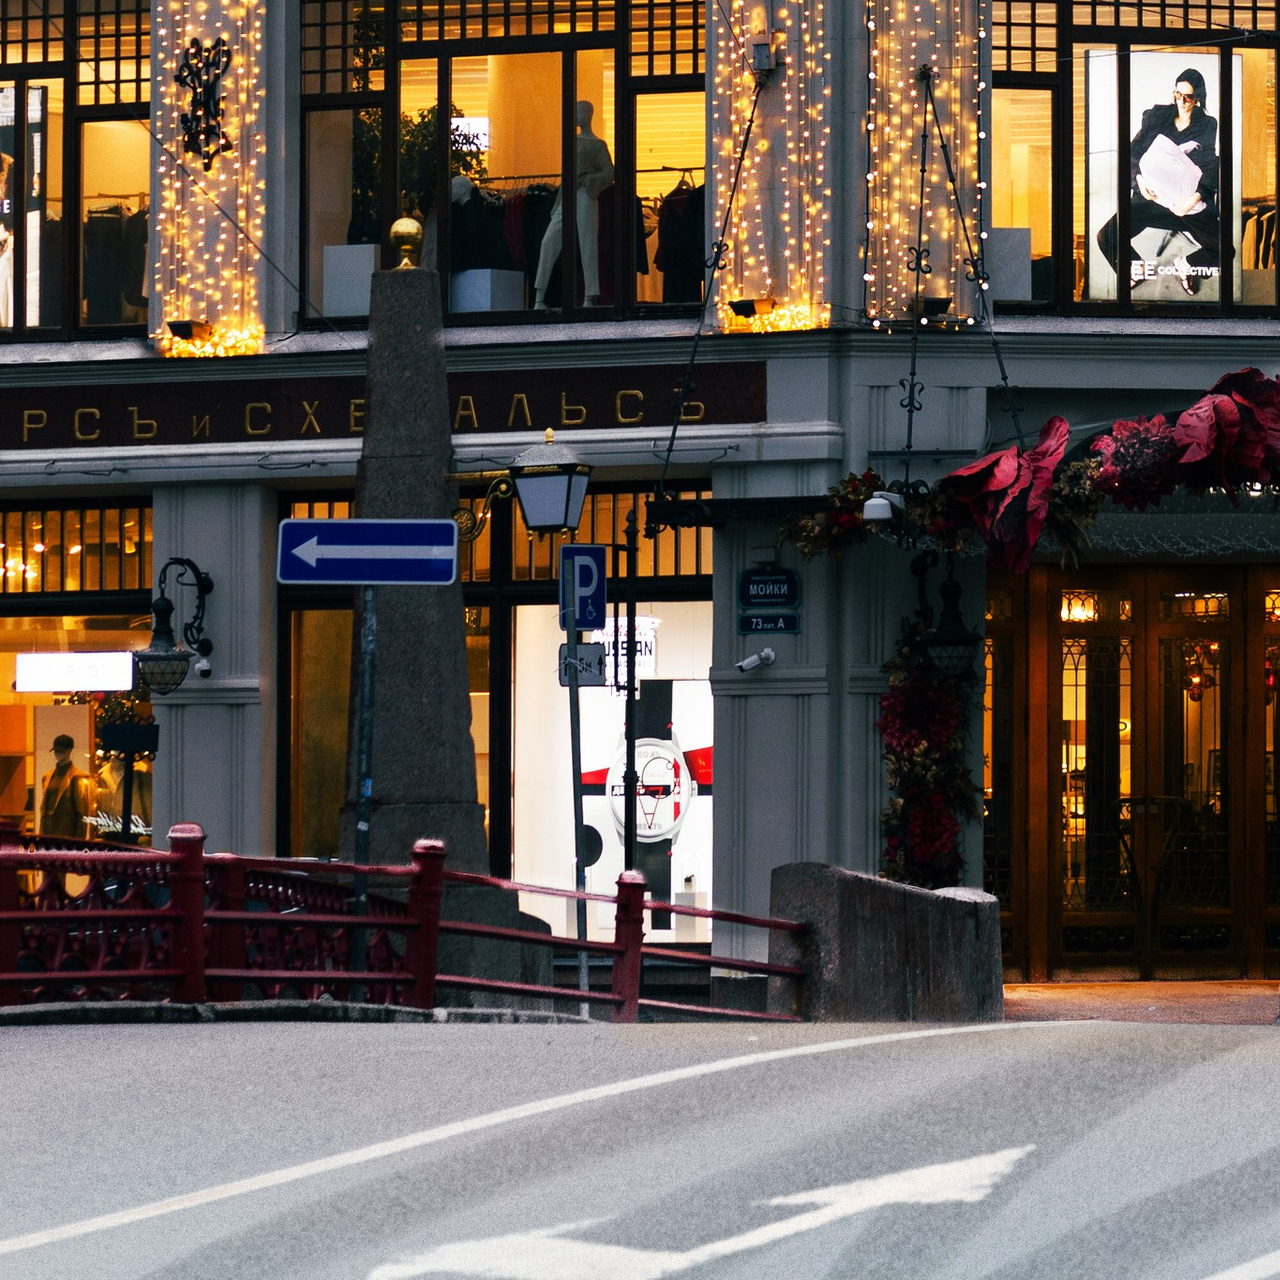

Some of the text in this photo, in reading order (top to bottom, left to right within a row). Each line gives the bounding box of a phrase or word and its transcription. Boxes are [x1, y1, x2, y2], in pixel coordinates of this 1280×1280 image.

[22, 387, 707, 442] РСЪ и СХЕАЛЬСЪ
[574, 555, 599, 620] P
[748, 581, 788, 596] МОЙКИ
[751, 618, 763, 630] 73
[777, 617, 786, 630] А
